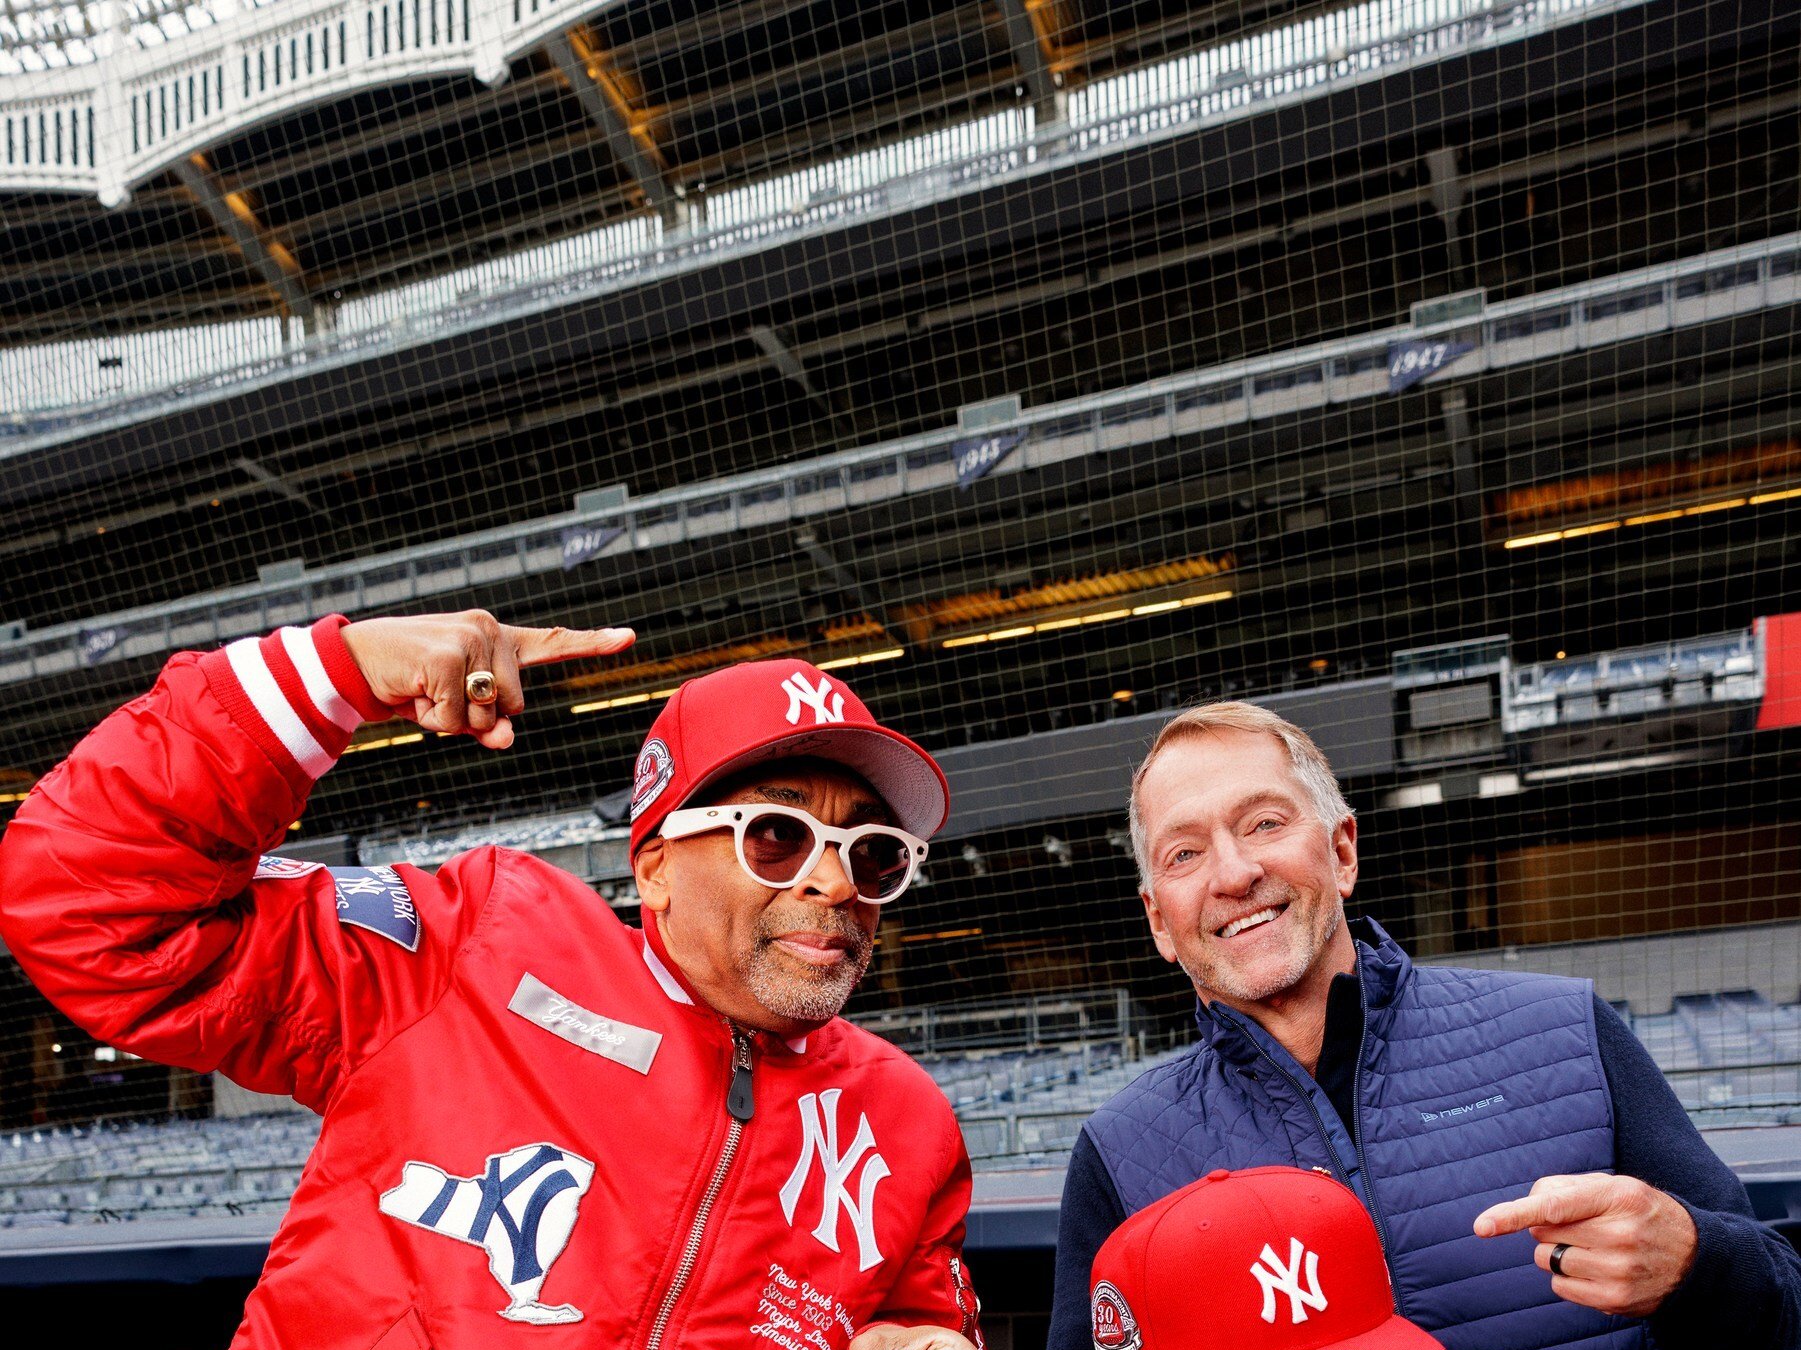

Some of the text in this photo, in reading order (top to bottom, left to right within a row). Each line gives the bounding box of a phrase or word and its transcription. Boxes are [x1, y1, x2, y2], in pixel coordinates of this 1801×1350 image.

[781, 671, 845, 725] NY
[387, 886, 416, 926] YORK
[541, 996, 626, 1046] Yankees
[779, 1088, 892, 1273] NY
[767, 1263, 798, 1290] New
[801, 1282, 833, 1311] York
[1249, 1236, 1328, 1325] NY
[757, 1298, 802, 1334] Major
[763, 1283, 833, 1332] Since 1903
[1097, 1304, 1114, 1324] 30
